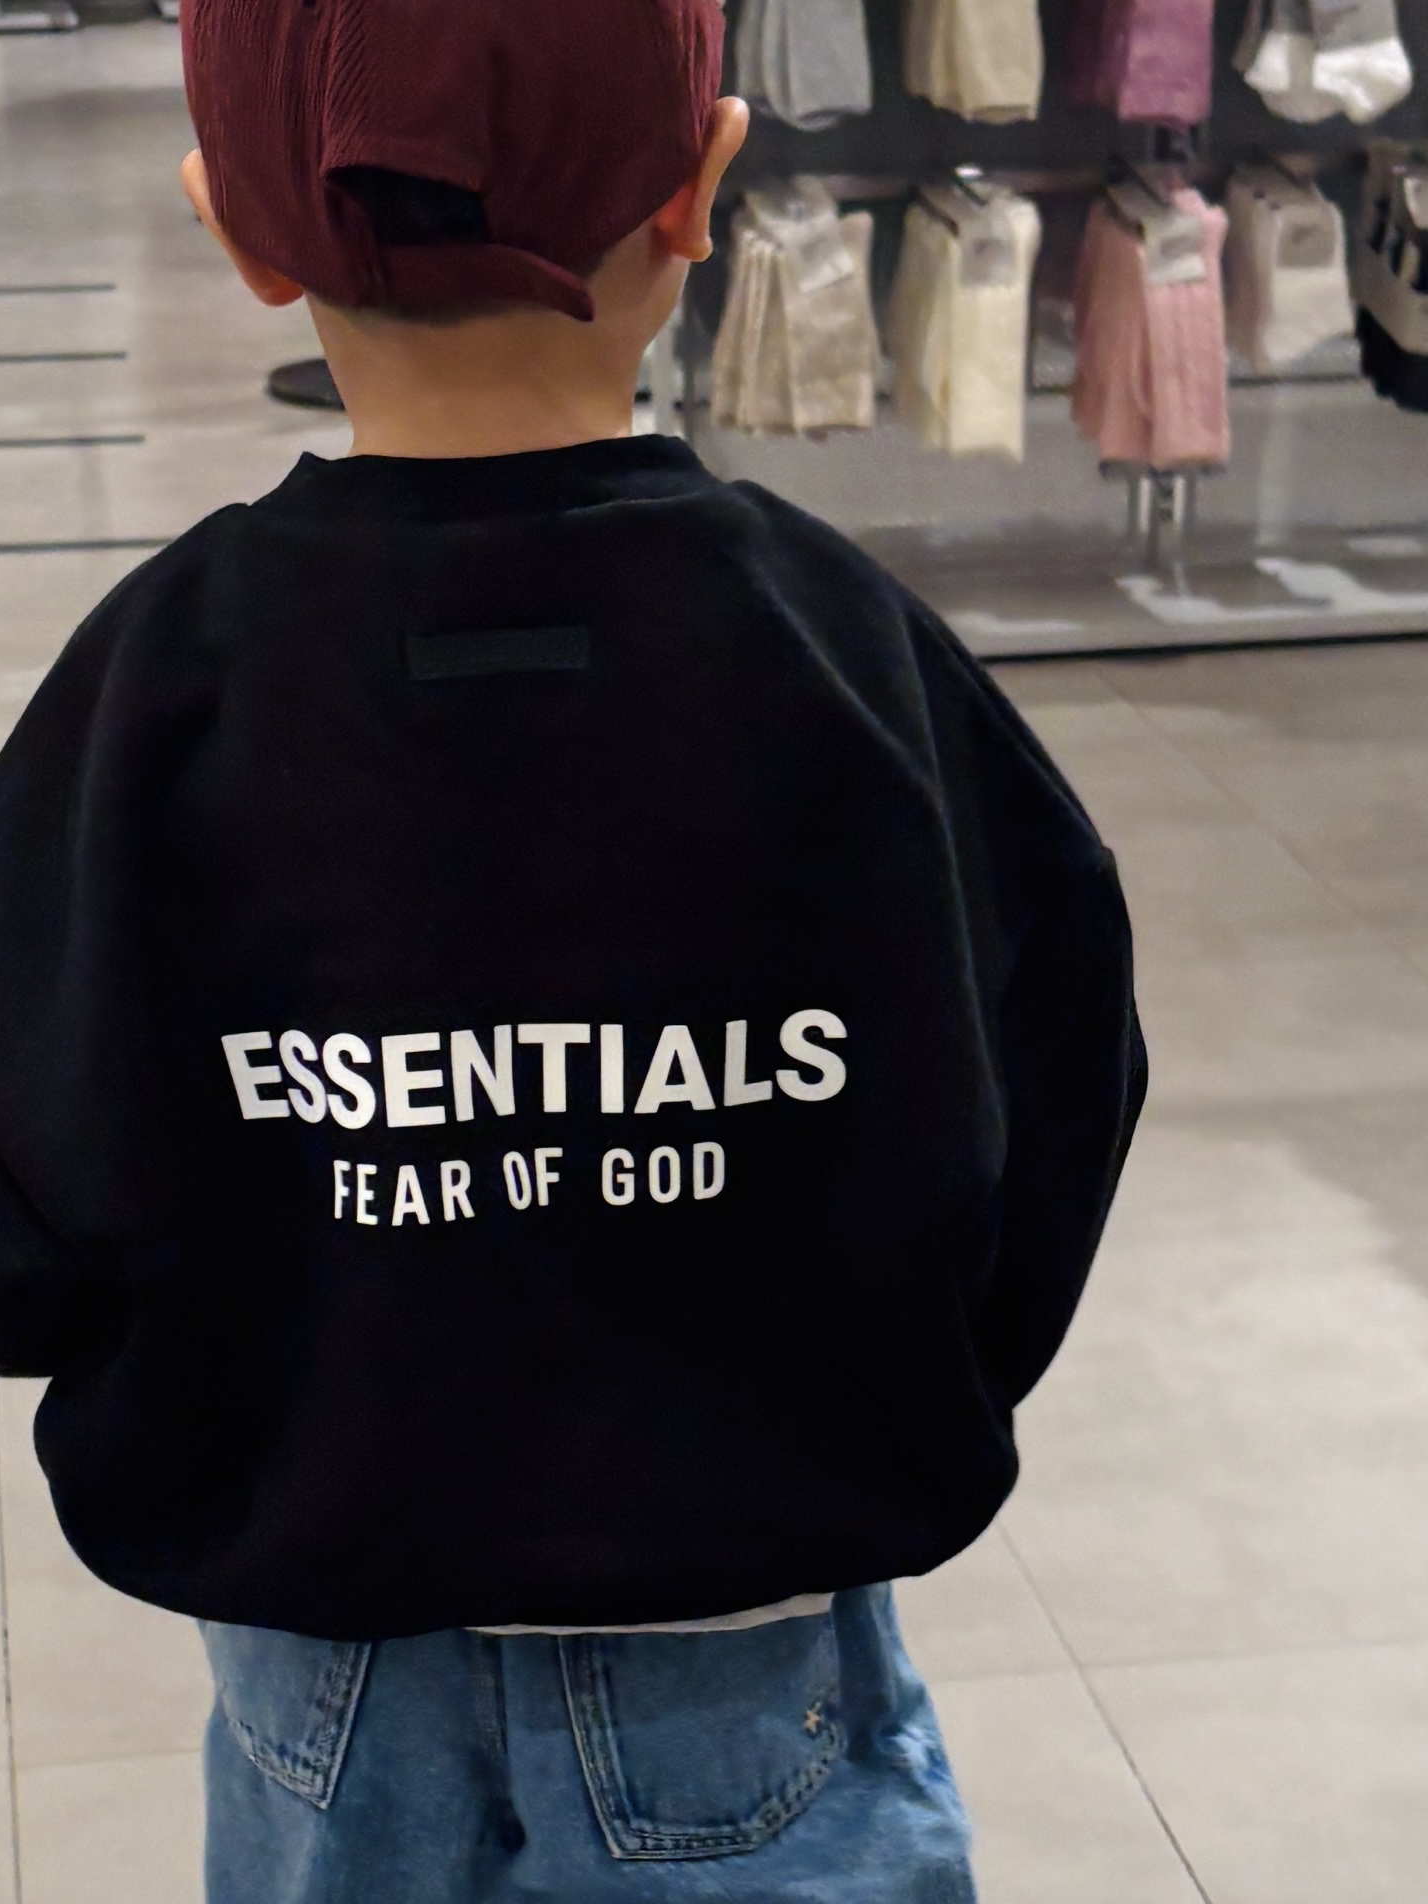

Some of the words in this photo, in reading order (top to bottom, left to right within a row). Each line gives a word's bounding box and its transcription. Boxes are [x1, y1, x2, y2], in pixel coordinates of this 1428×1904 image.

[221, 1009, 847, 1129] ESSENTIALS
[334, 1160, 474, 1226] FEAR
[503, 1148, 562, 1209] OF
[602, 1142, 724, 1205] GOD
